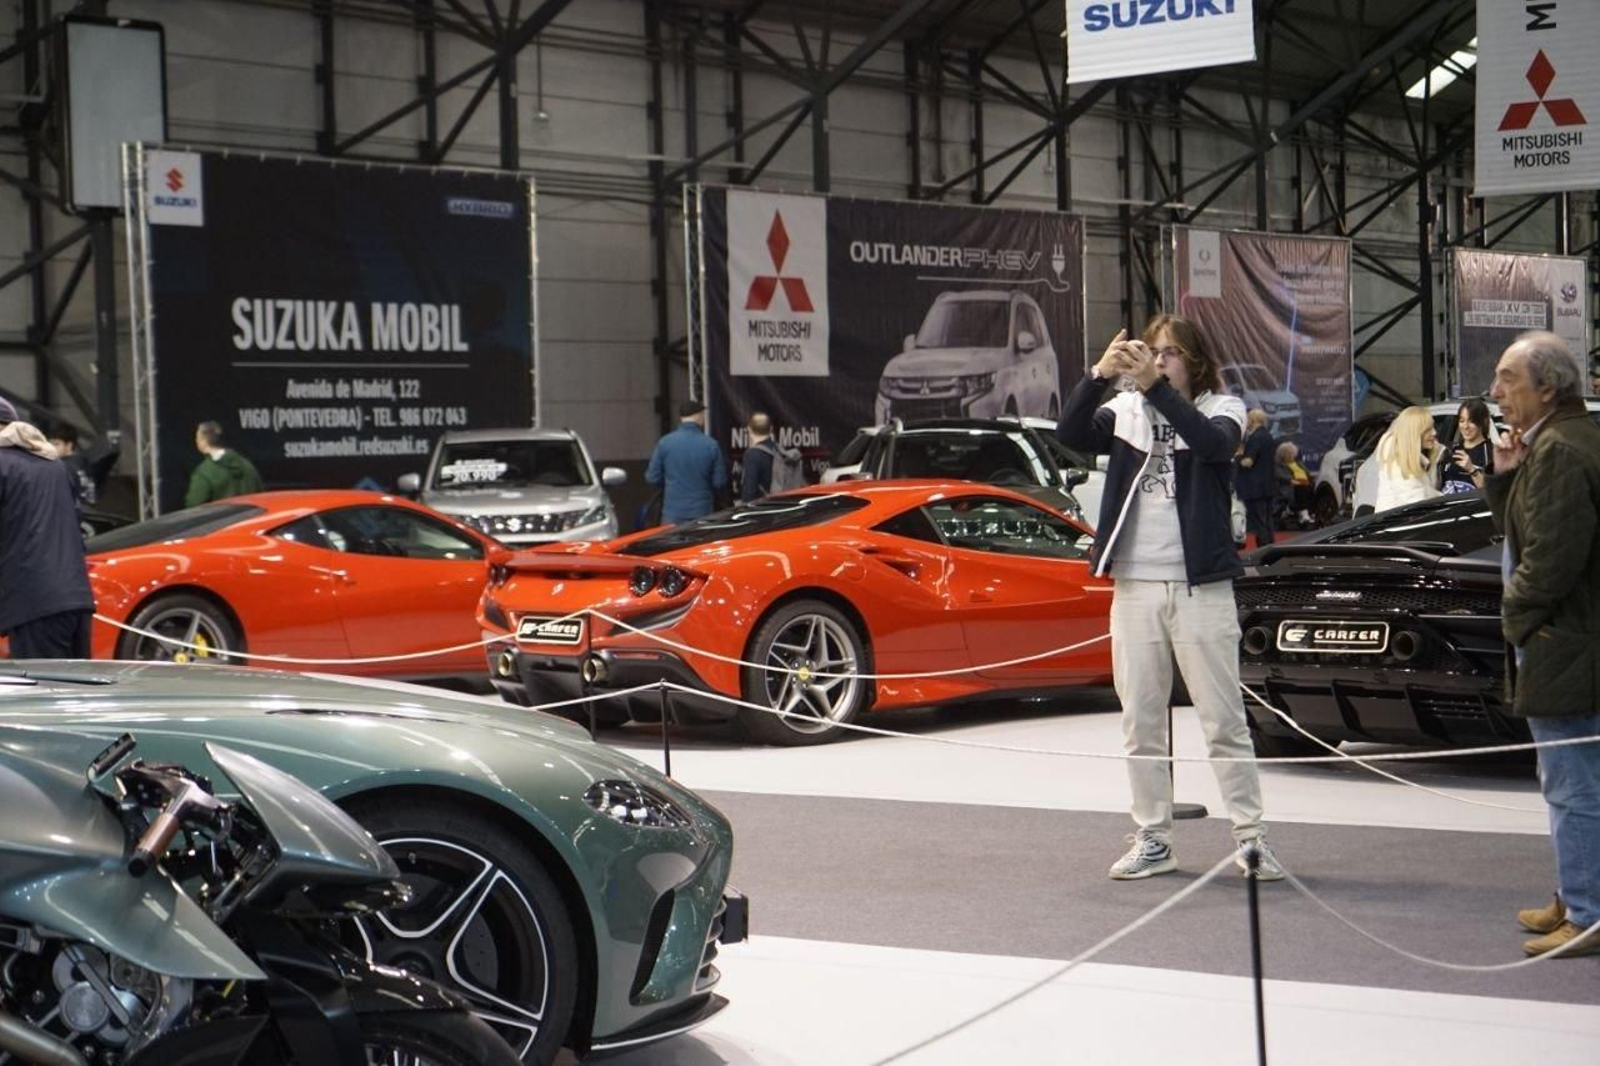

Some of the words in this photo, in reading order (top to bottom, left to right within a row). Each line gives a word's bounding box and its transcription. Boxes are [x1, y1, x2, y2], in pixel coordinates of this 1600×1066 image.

[1502, 131, 1582, 151] MITSUBISHI
[1514, 151, 1571, 168] MOTORS
[154, 195, 197, 207] SUZUKI
[231, 297, 362, 351] SUZUKA
[371, 302, 469, 352] MOBIL
[748, 319, 811, 340] MITSUBISHI
[757, 343, 803, 363] MOTORS
[286, 379, 333, 398] Avenida
[336, 379, 350, 398] de
[399, 379, 420, 398] 122
[239, 408, 270, 429] VIGO
[272, 406, 361, 432] (PONTEVEDRA)
[372, 407, 396, 427] TEL.
[399, 407, 420, 427] 986
[423, 407, 443, 426] 072
[445, 406, 467, 426] 043
[779, 426, 820, 448] Mobil
[1313, 629, 1380, 641] CARFER
